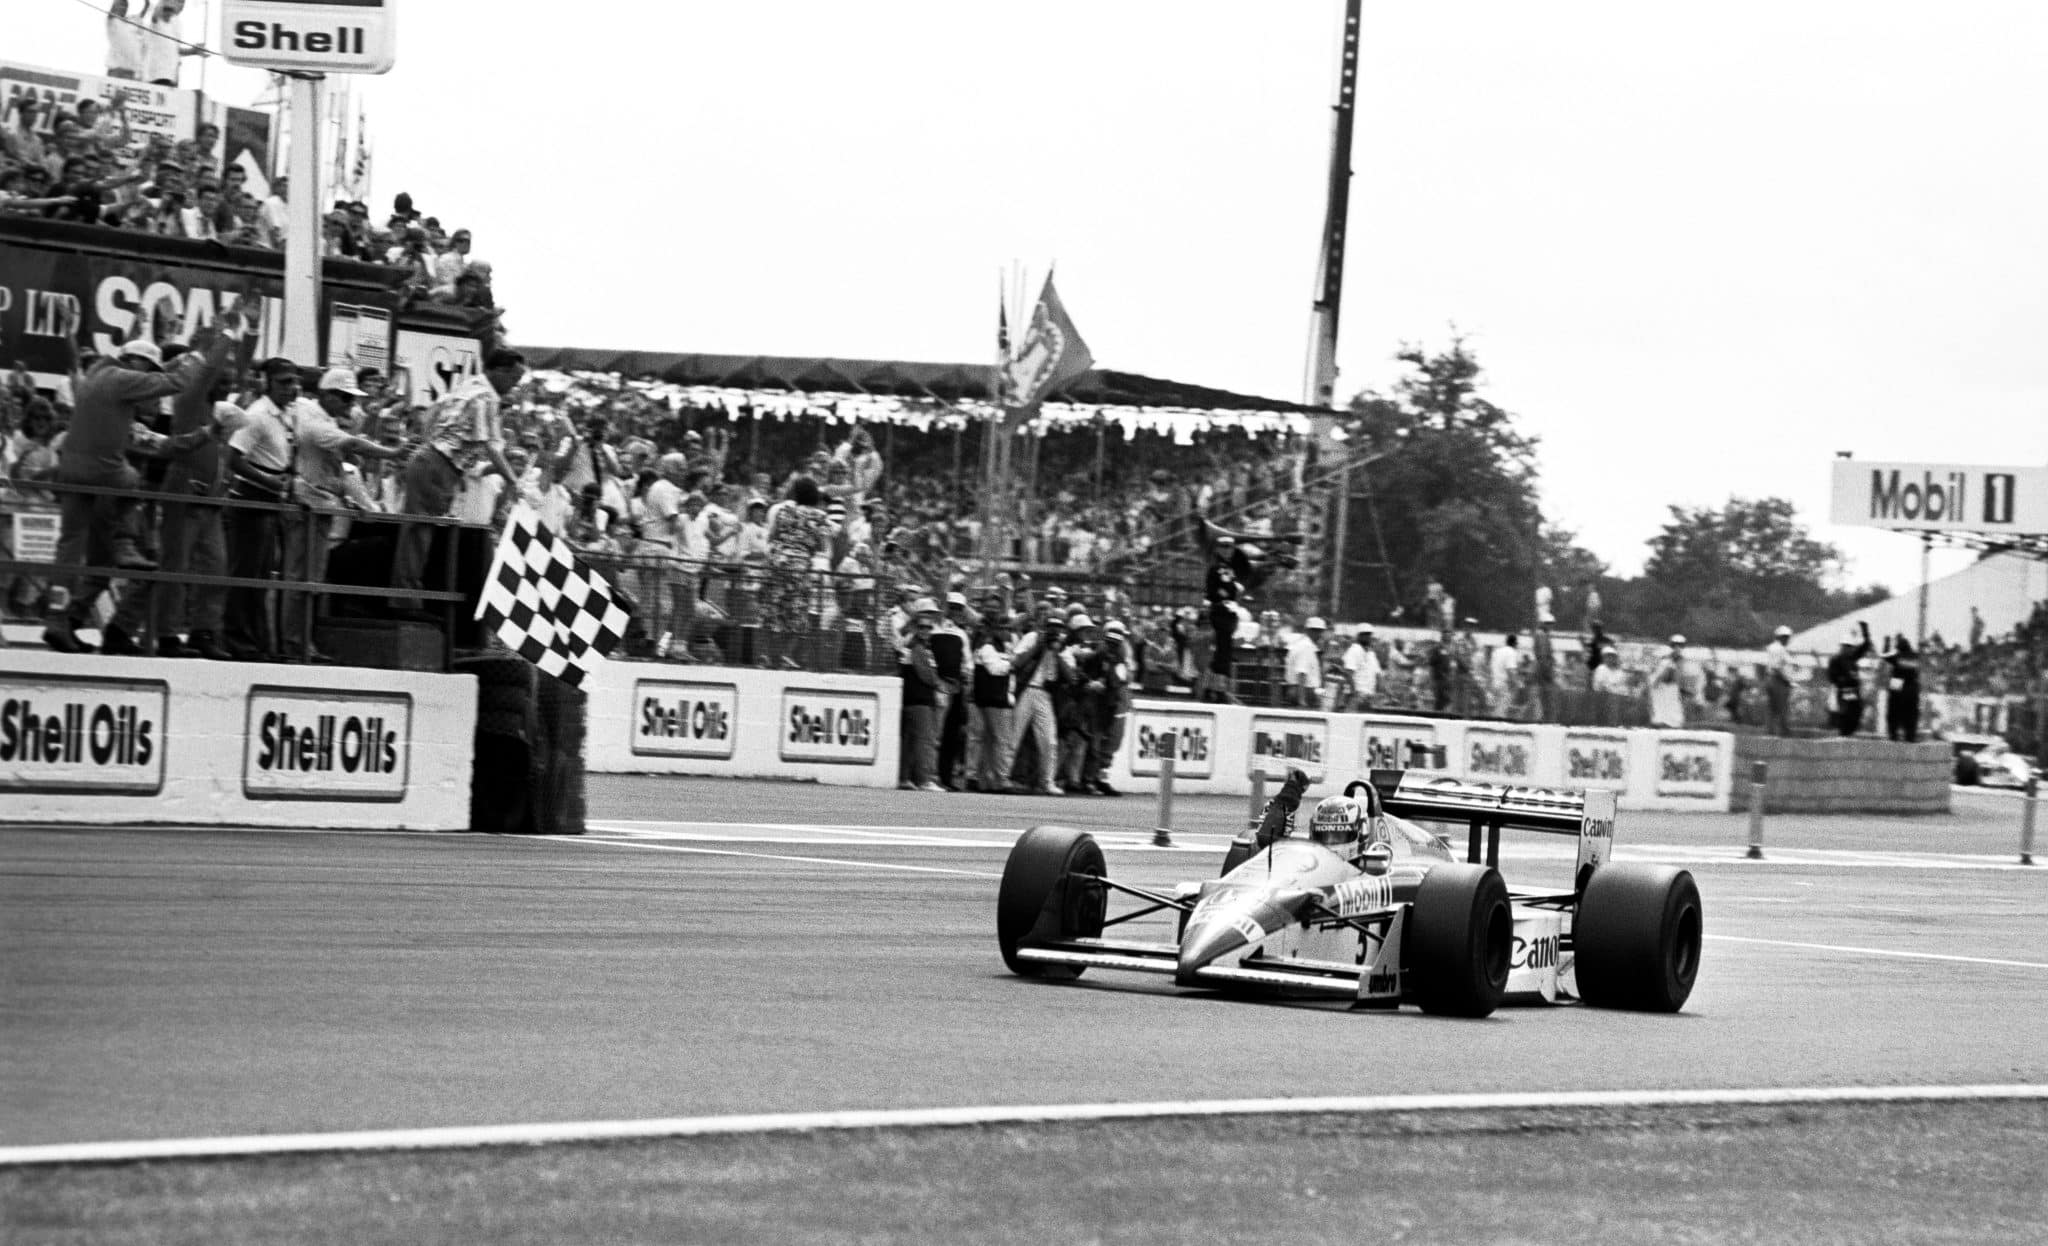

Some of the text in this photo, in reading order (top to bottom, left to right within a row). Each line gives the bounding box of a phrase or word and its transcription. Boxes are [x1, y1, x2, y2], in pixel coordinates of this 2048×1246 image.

[234, 20, 364, 54] Shell
[1870, 469, 2011, 523] Mobil 1
[0, 698, 153, 766] Shell Oils
[641, 696, 728, 740] Shell Oils
[789, 704, 870, 746] Shell Oils
[258, 710, 397, 774] Shell Oils
[1180, 727, 1208, 761] Oils
[1314, 824, 1353, 833] HONDA
